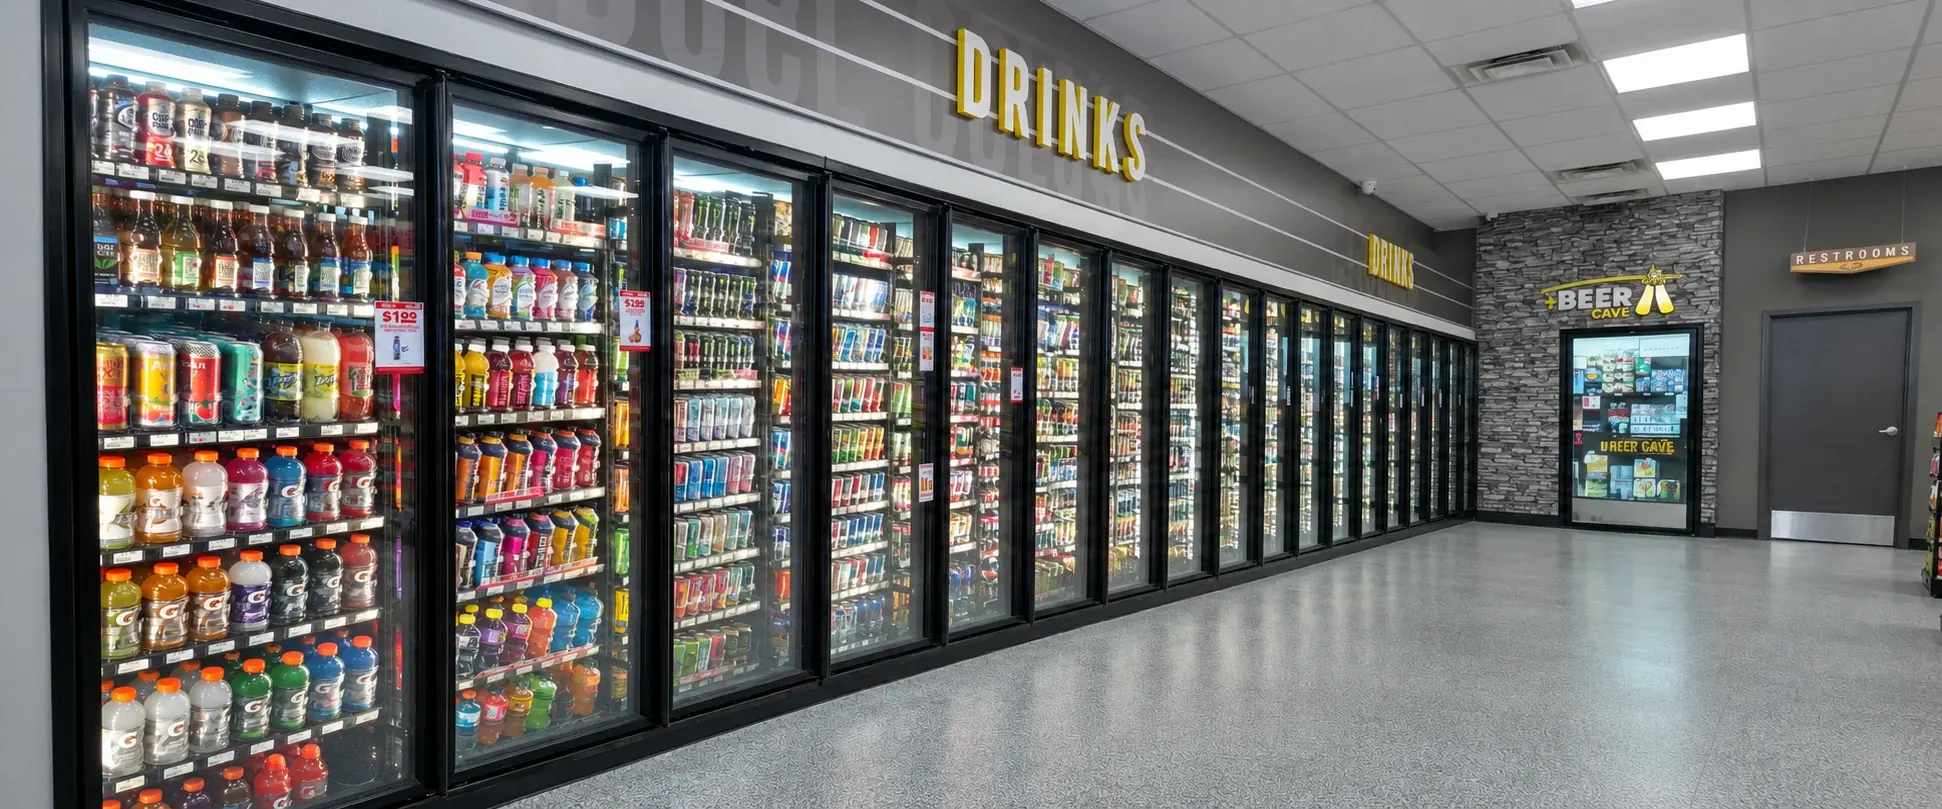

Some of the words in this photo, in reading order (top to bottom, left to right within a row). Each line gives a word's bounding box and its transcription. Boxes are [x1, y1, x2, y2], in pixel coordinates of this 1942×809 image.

[956, 28, 1147, 182] DRINKS
[1368, 232, 1414, 290] DRINKS
[1796, 245, 1909, 265] RESTROOMS
[1557, 286, 1633, 311] BEER
[1591, 307, 1631, 320] CAVE
